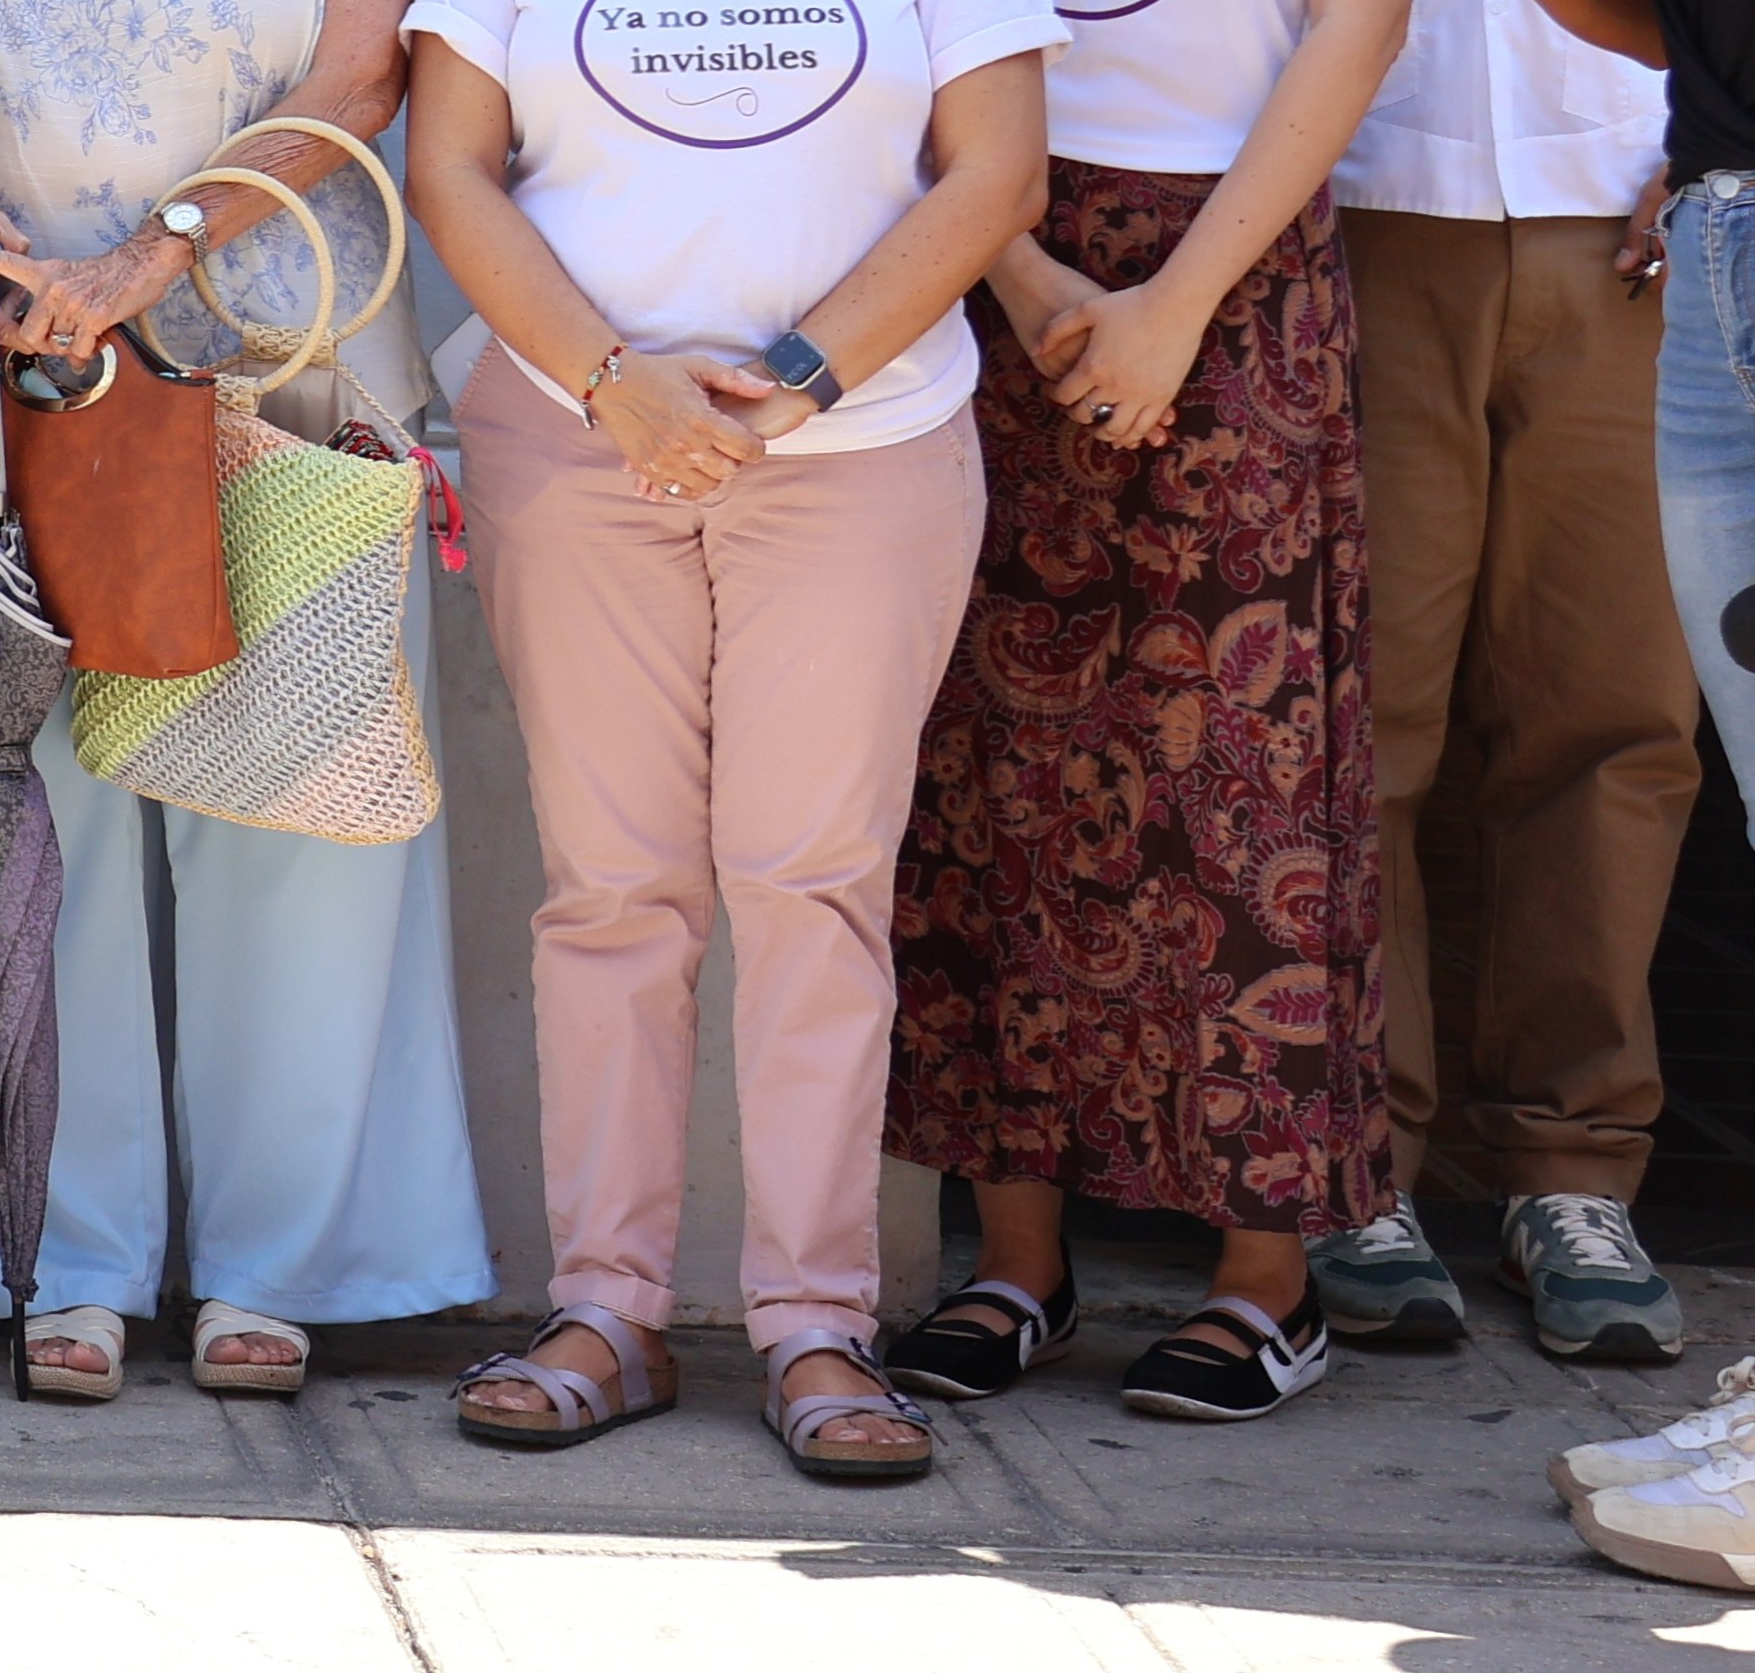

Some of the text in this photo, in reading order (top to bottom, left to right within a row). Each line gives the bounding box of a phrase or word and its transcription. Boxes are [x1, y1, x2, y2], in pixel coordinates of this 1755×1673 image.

[597, 6, 845, 31] Ya no somos
[630, 42, 818, 74] invisibles
